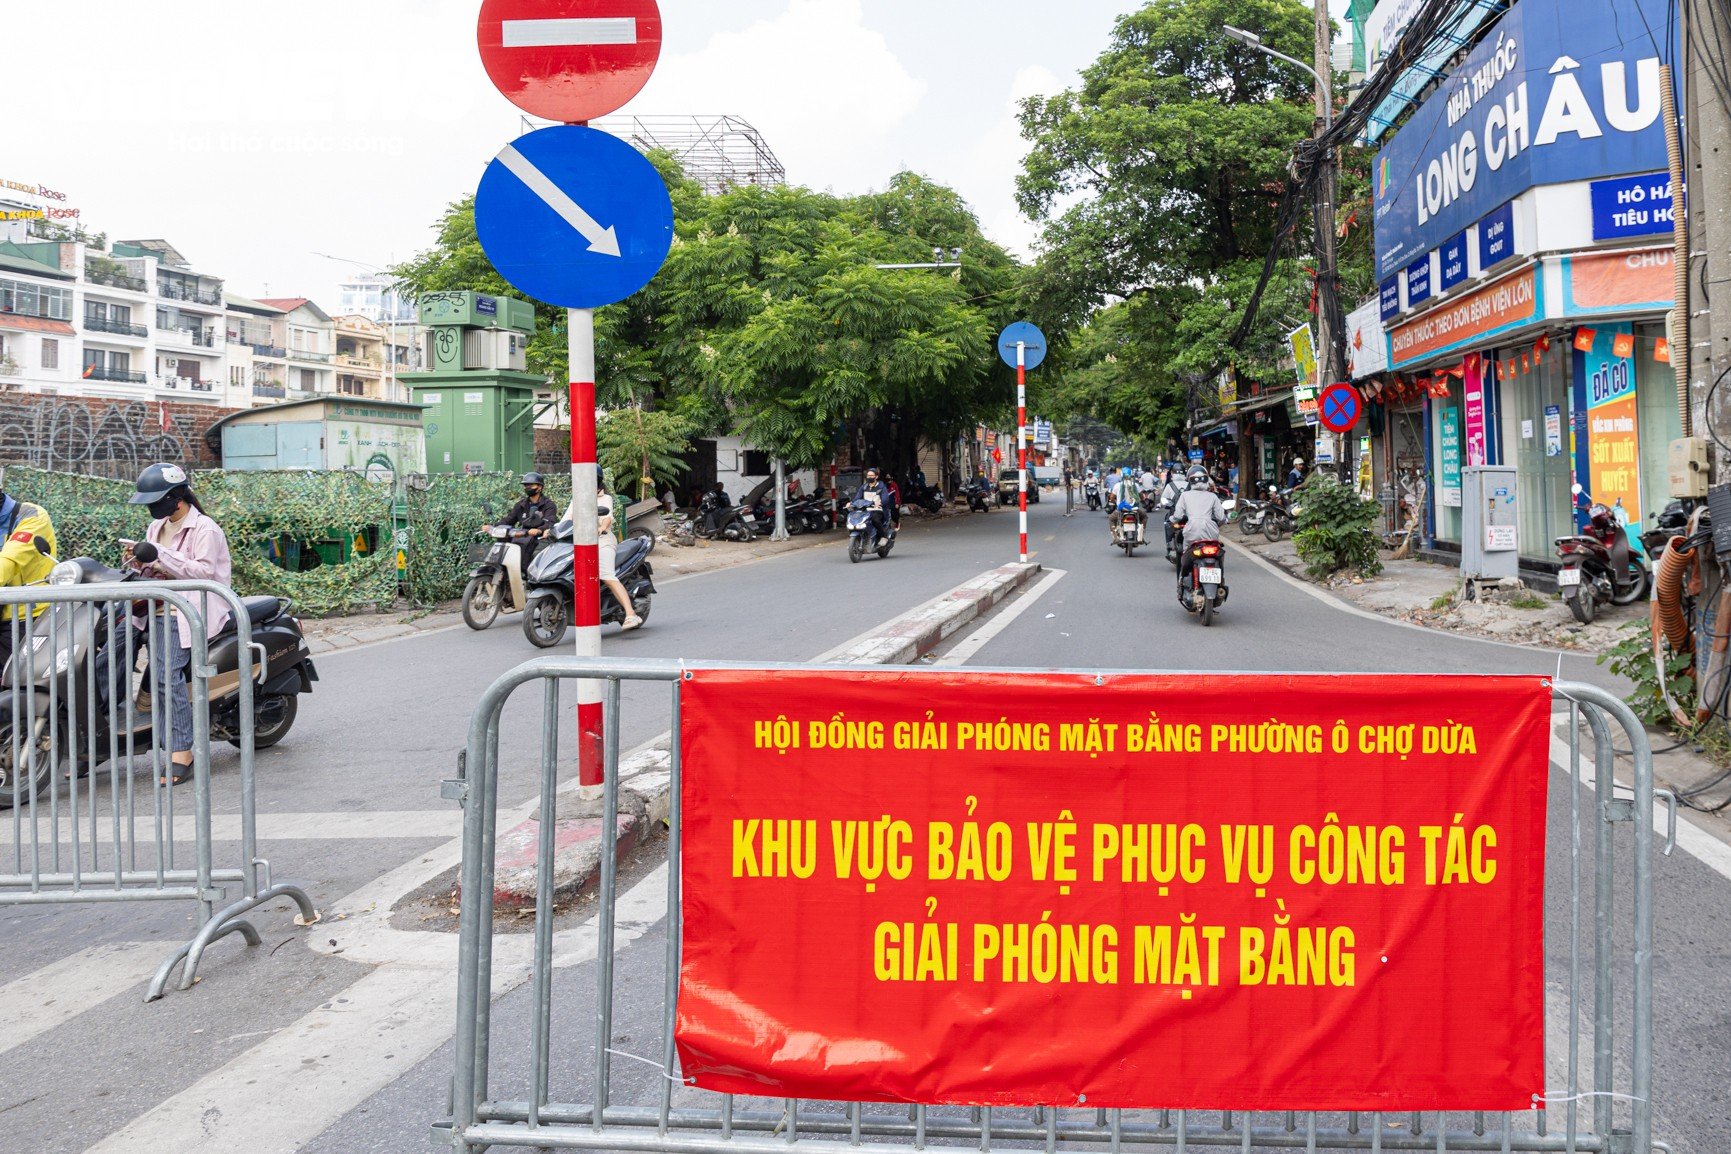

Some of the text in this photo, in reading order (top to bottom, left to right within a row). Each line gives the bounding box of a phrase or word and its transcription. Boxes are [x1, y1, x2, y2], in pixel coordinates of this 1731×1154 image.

[1447, 77, 1472, 127] NHÀ
[1472, 31, 1517, 103] THUỐC
[1416, 55, 1661, 226] LONG CHÂU
[38, 183, 66, 201] Rose
[1617, 184, 1645, 204] HÔ
[8, 209, 44, 219] KHOA
[46, 205, 80, 219] Rose
[1612, 207, 1648, 227] TIÊU
[1448, 247, 1458, 260] GAN
[1490, 239, 1503, 255] GOUT
[1393, 277, 1532, 352] CHUYÊN THUỐC THEO ĐƠN BỆNH VIỆN LỚN
[1593, 357, 1628, 402] ĐÃ CÓ
[1444, 423, 1454, 434] TIÊM
[1592, 415, 1603, 433] VẮC
[1614, 416, 1633, 432] PHÒNG
[1442, 434, 1457, 446] CHỦNG
[1593, 436, 1634, 463] SỐT XUẤT
[1444, 450, 1457, 460] LONG
[1444, 461, 1458, 474] CHÂU
[1601, 466, 1629, 492] HUYẾT
[267, 648, 289, 663] Fashion
[755, 711, 1476, 760] HỘI ĐỒNG GIẢI PHÓNG MẶT BẰNG PHƯỜNG Ô CHỢ DỪA
[733, 796, 1496, 897] KHU VỰC BẢO VỆ PHỤC VỤ CÔNG TÁC
[875, 897, 1354, 999] GIẢI PHÓNG MẶT BẰNG
